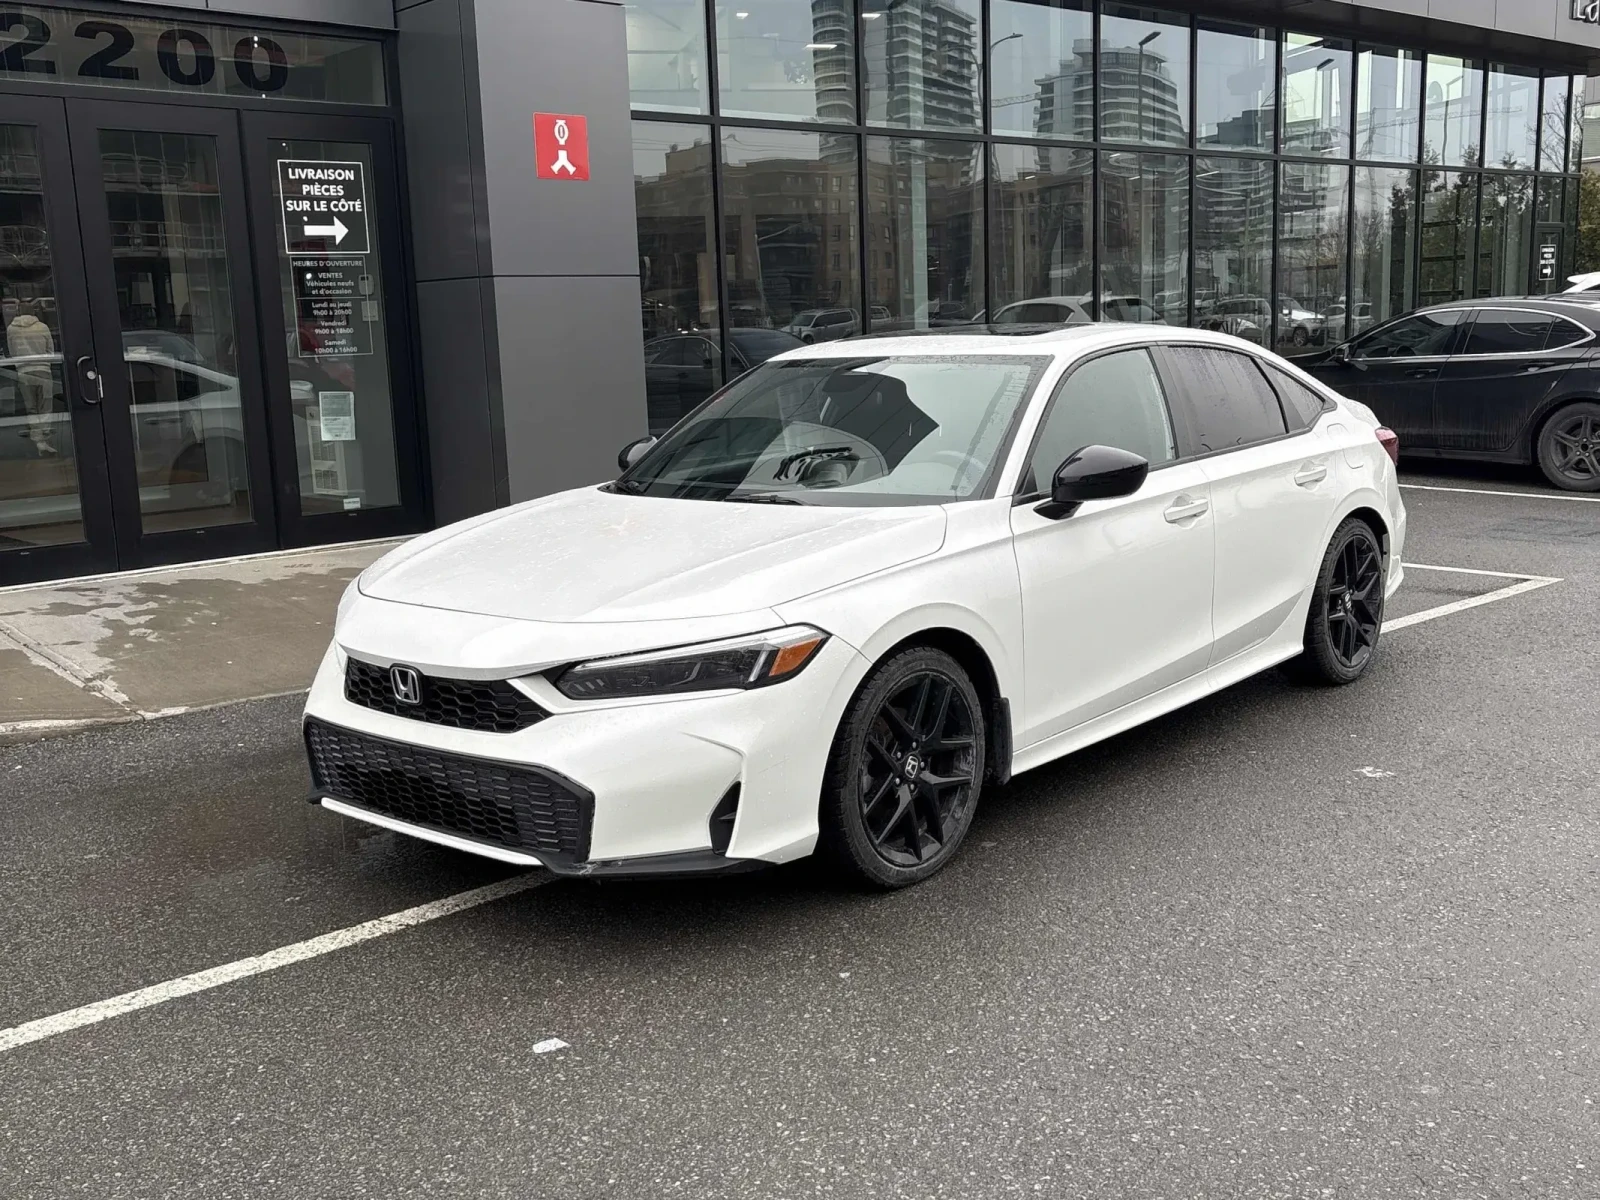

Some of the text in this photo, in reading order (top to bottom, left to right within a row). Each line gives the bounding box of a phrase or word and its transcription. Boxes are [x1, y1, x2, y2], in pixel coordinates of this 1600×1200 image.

[0, 12, 289, 92] 2200
[288, 168, 355, 180] LIVRAISON
[302, 182, 344, 196] PIÈCES
[286, 198, 362, 212] SUR LE CÔTÉ
